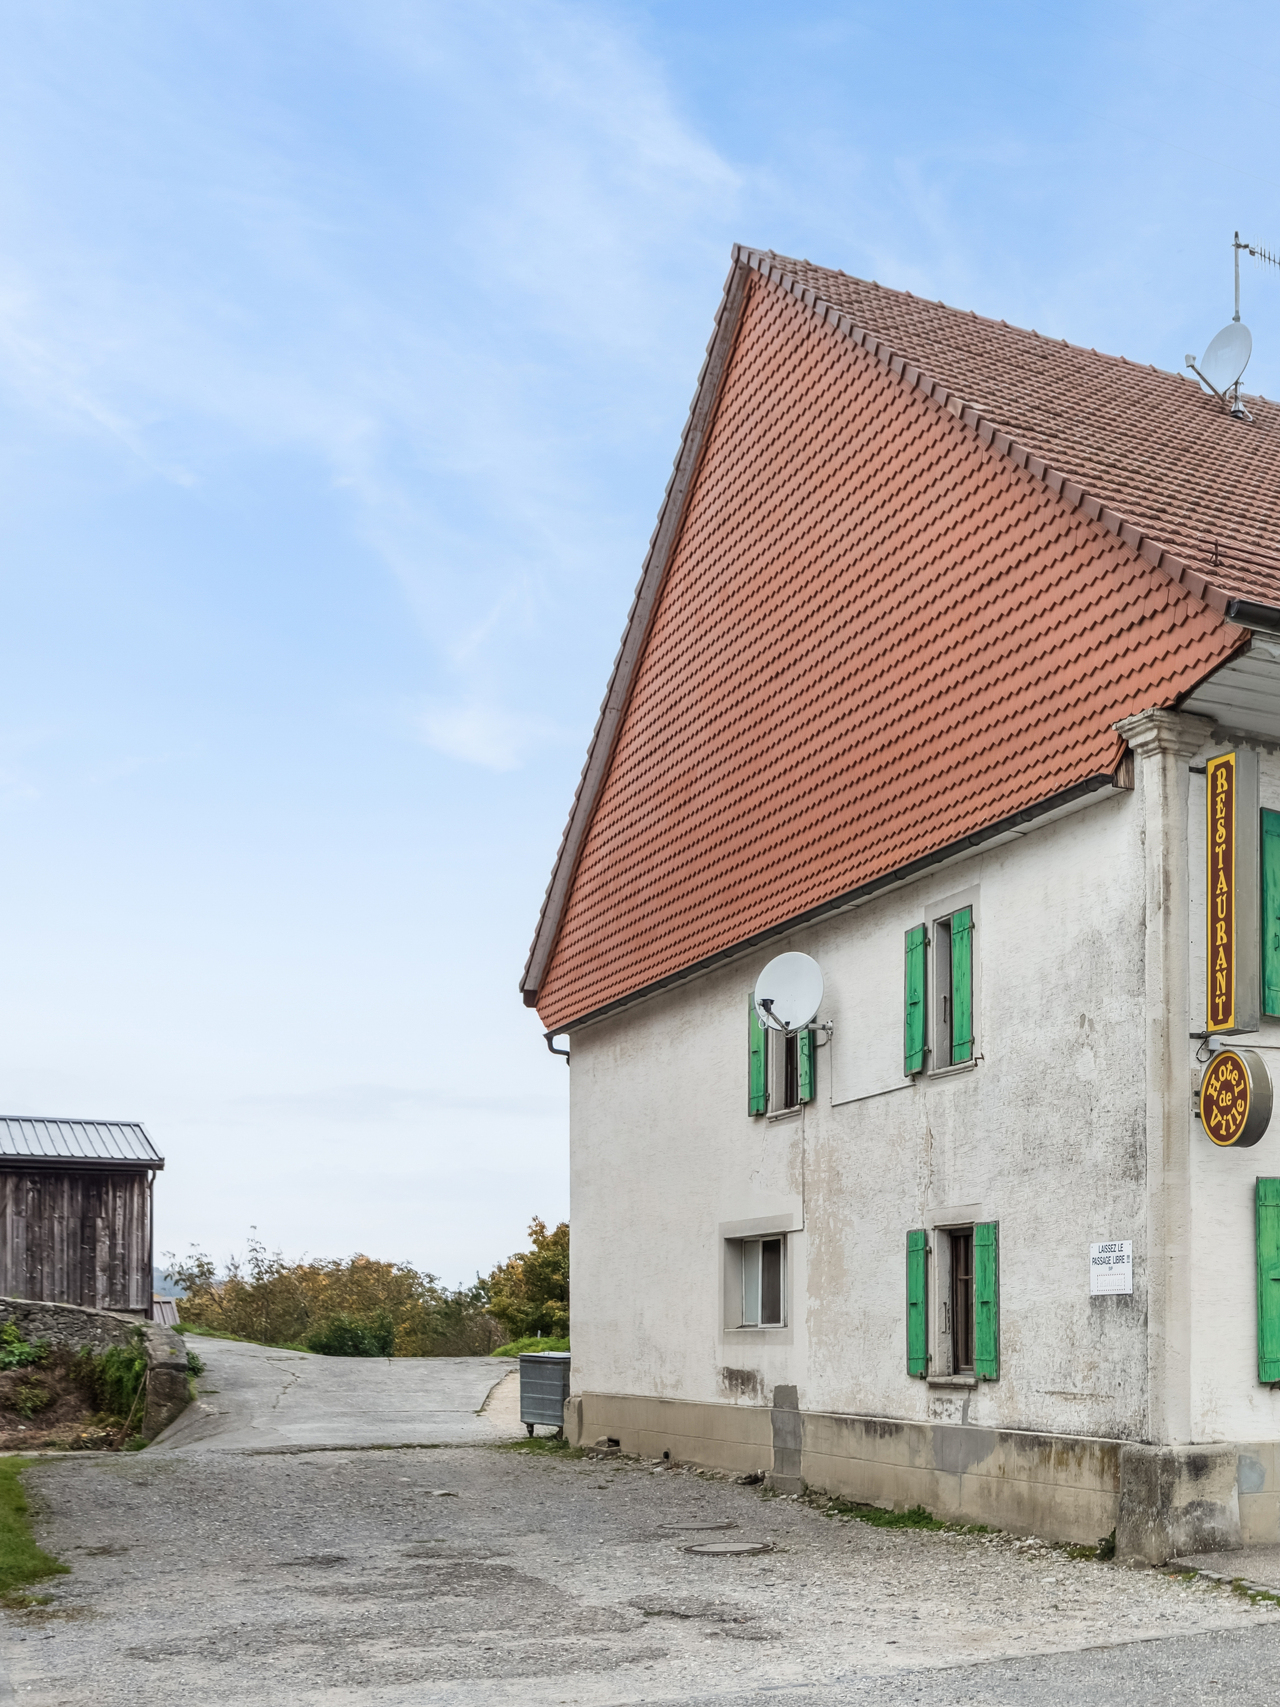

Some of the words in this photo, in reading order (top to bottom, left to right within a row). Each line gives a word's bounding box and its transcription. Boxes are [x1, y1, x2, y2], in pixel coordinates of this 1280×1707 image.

[1215, 767, 1229, 1020] RESTAURANT
[1206, 1060, 1245, 1100] Hotel
[1219, 1090, 1233, 1107] de
[1209, 1098, 1245, 1136] Ville
[1092, 1255, 1111, 1265] PASSAGE
[1113, 1254, 1125, 1264] LIBRE
[1099, 1244, 1116, 1253] LAISSEZ
[1118, 1243, 1123, 1252] LE
